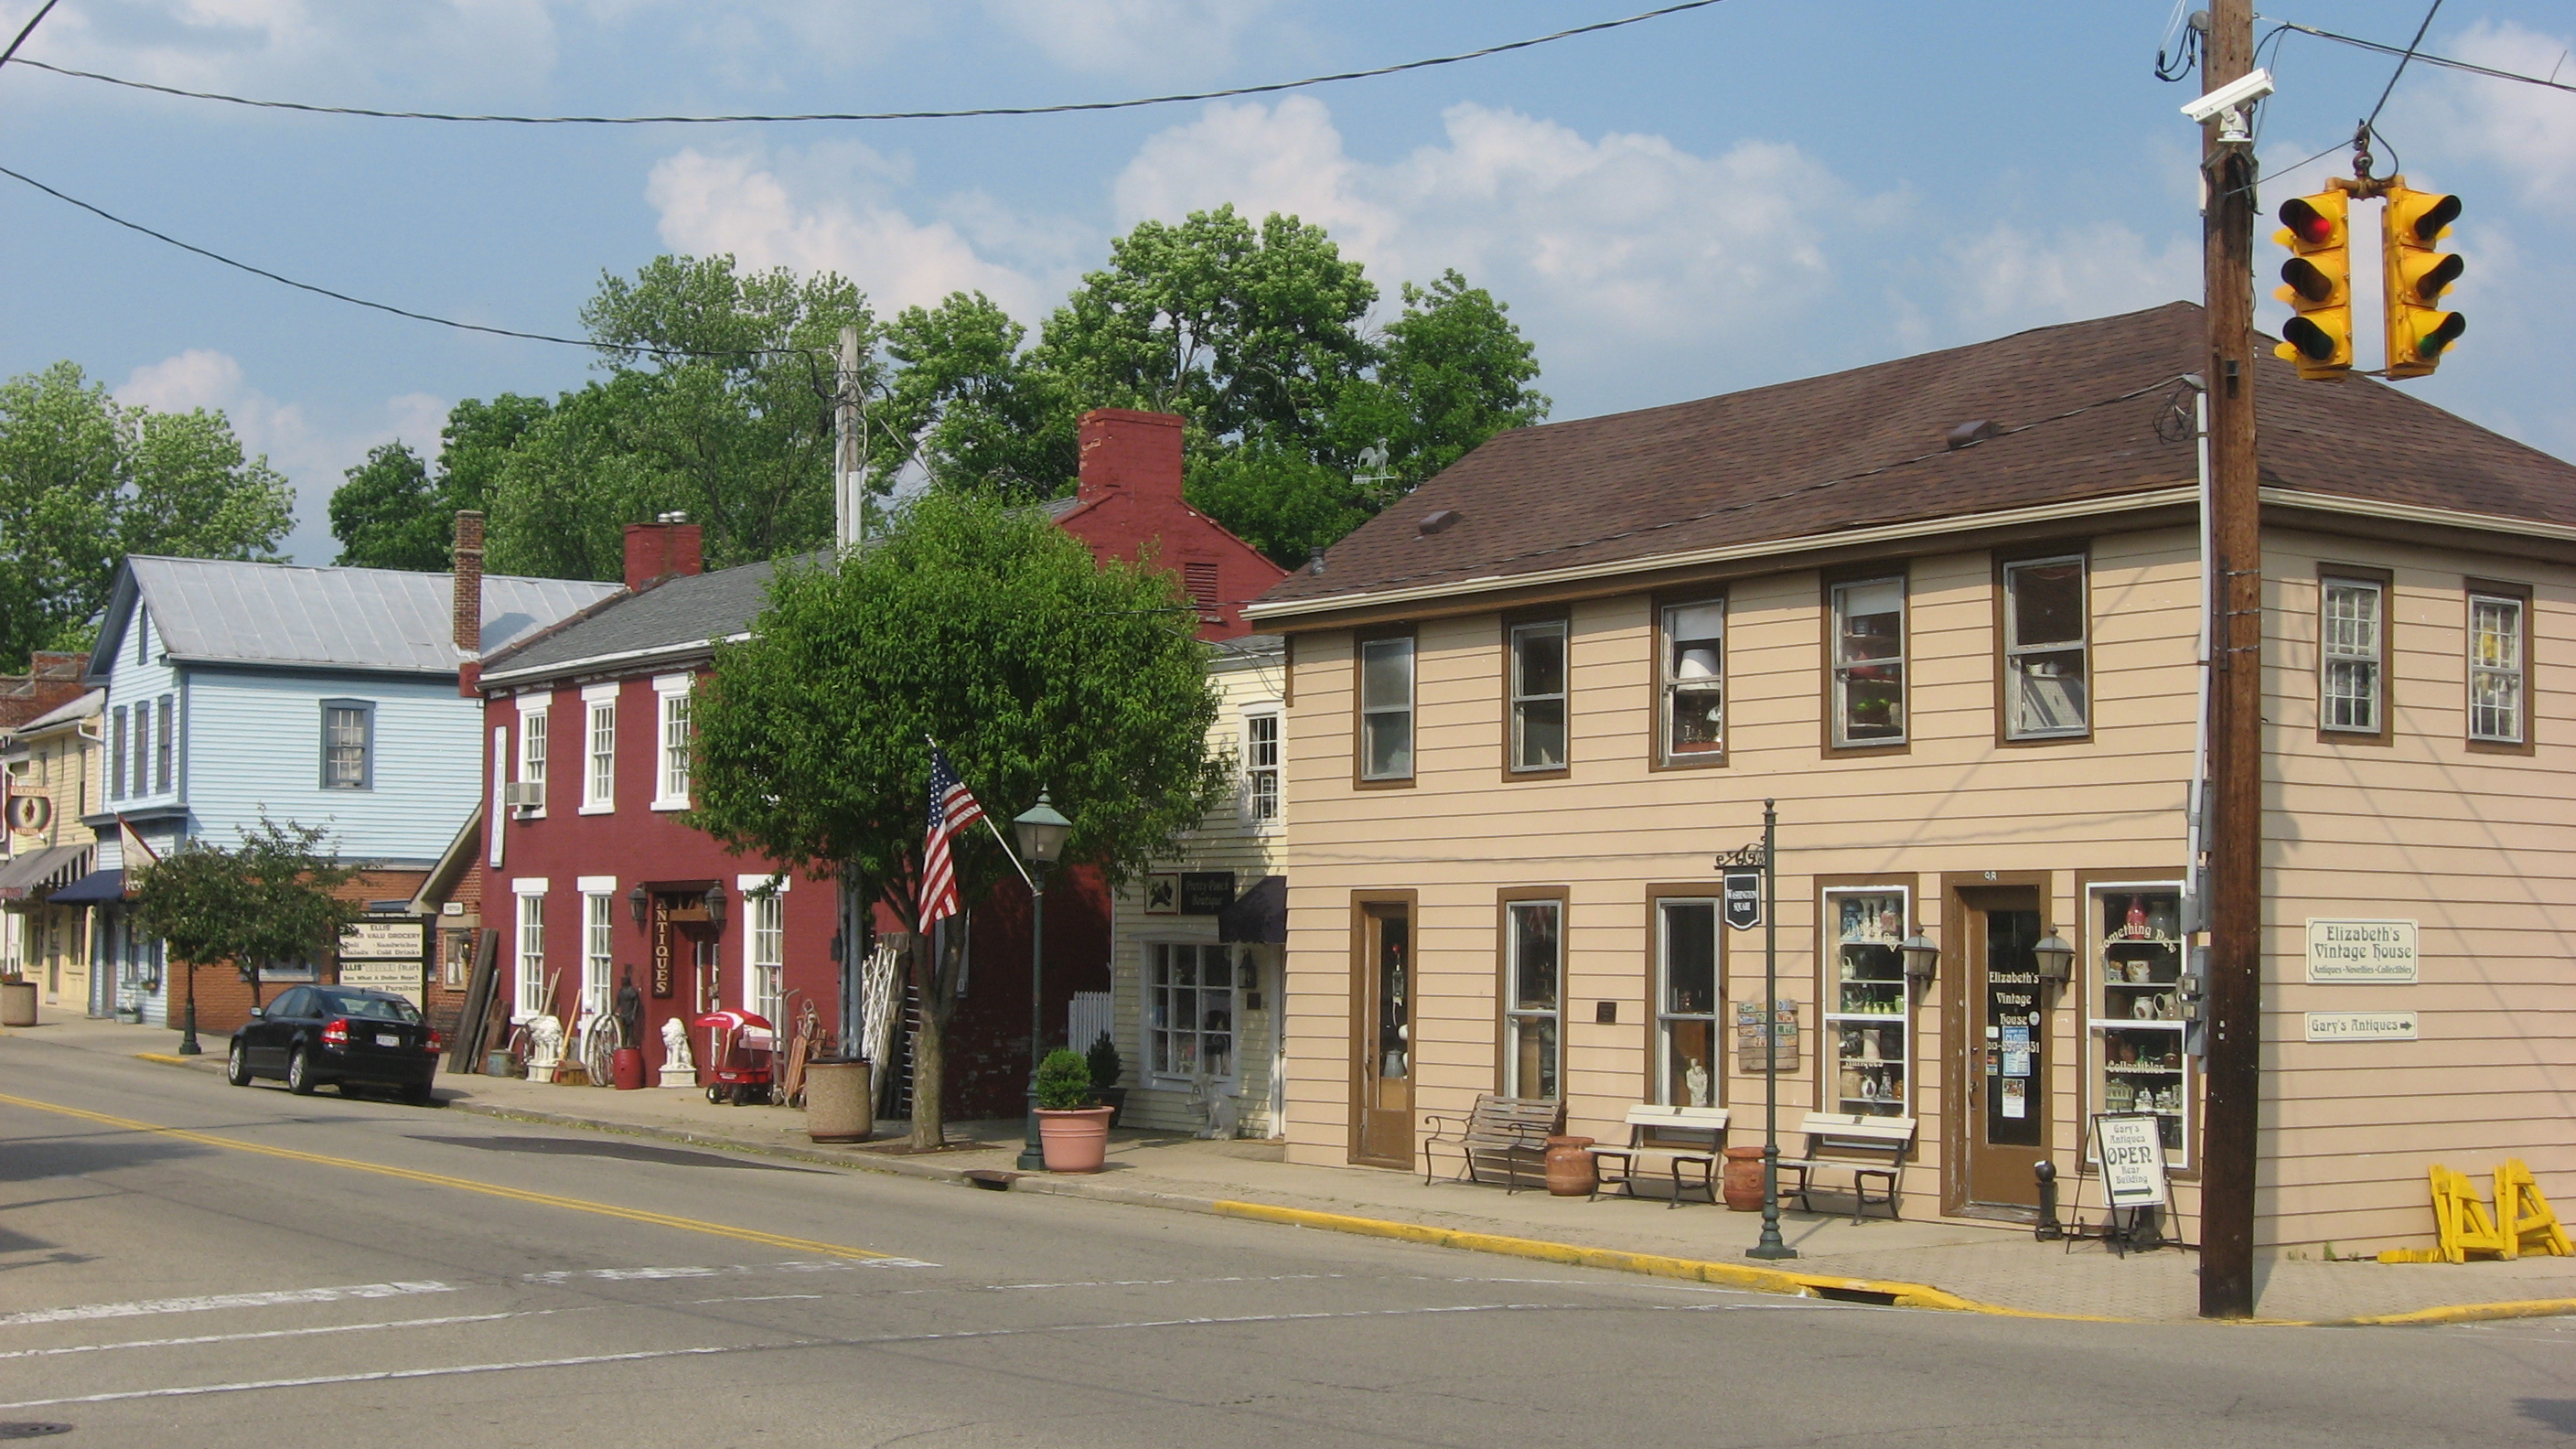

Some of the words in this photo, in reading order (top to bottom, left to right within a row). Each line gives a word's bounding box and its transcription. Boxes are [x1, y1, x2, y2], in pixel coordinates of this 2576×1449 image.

[2098, 922, 2152, 954] Something
[2326, 926, 2400, 942] Elizabeth's
[2314, 943, 2367, 961] Vintage
[1989, 971, 2039, 984] Elizabeth's
[1996, 992, 2032, 1007] Vintage
[2312, 1019, 2347, 1034] Gary's
[2351, 1019, 2399, 1033] Antiques
[2108, 1059, 2165, 1074] Collectibles
[2114, 1123, 2141, 1134] Gary's
[2109, 1135, 2146, 1145] Antiques
[2107, 1145, 2152, 1165] OPEN
[2121, 1165, 2141, 1175] Rear
[2116, 1175, 2149, 1185] Building
